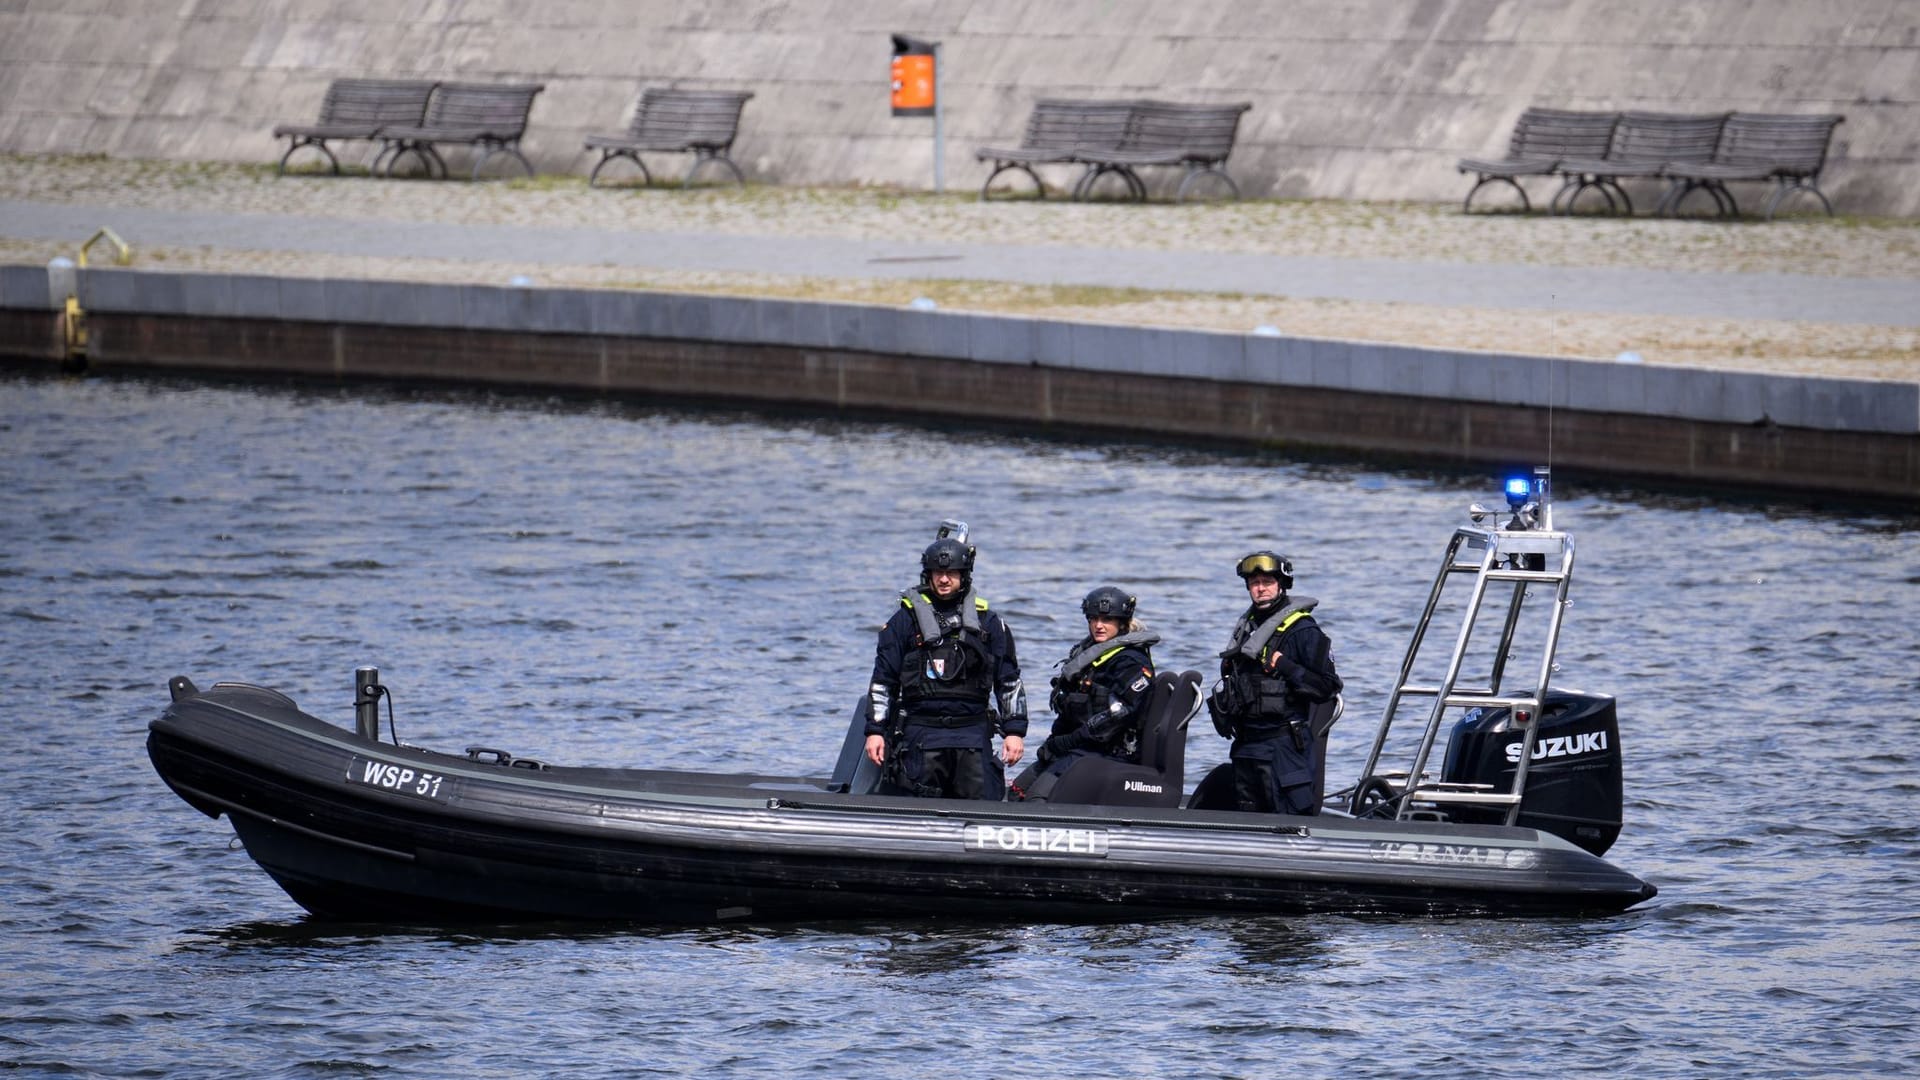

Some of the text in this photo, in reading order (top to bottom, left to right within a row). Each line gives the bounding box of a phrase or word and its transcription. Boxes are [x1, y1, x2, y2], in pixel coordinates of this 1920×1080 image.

[1505, 731, 1607, 762] SUZUKI
[363, 761, 443, 797] WSP 51
[1131, 781, 1162, 793] Ullman
[977, 826, 1096, 853] POLIZEI
